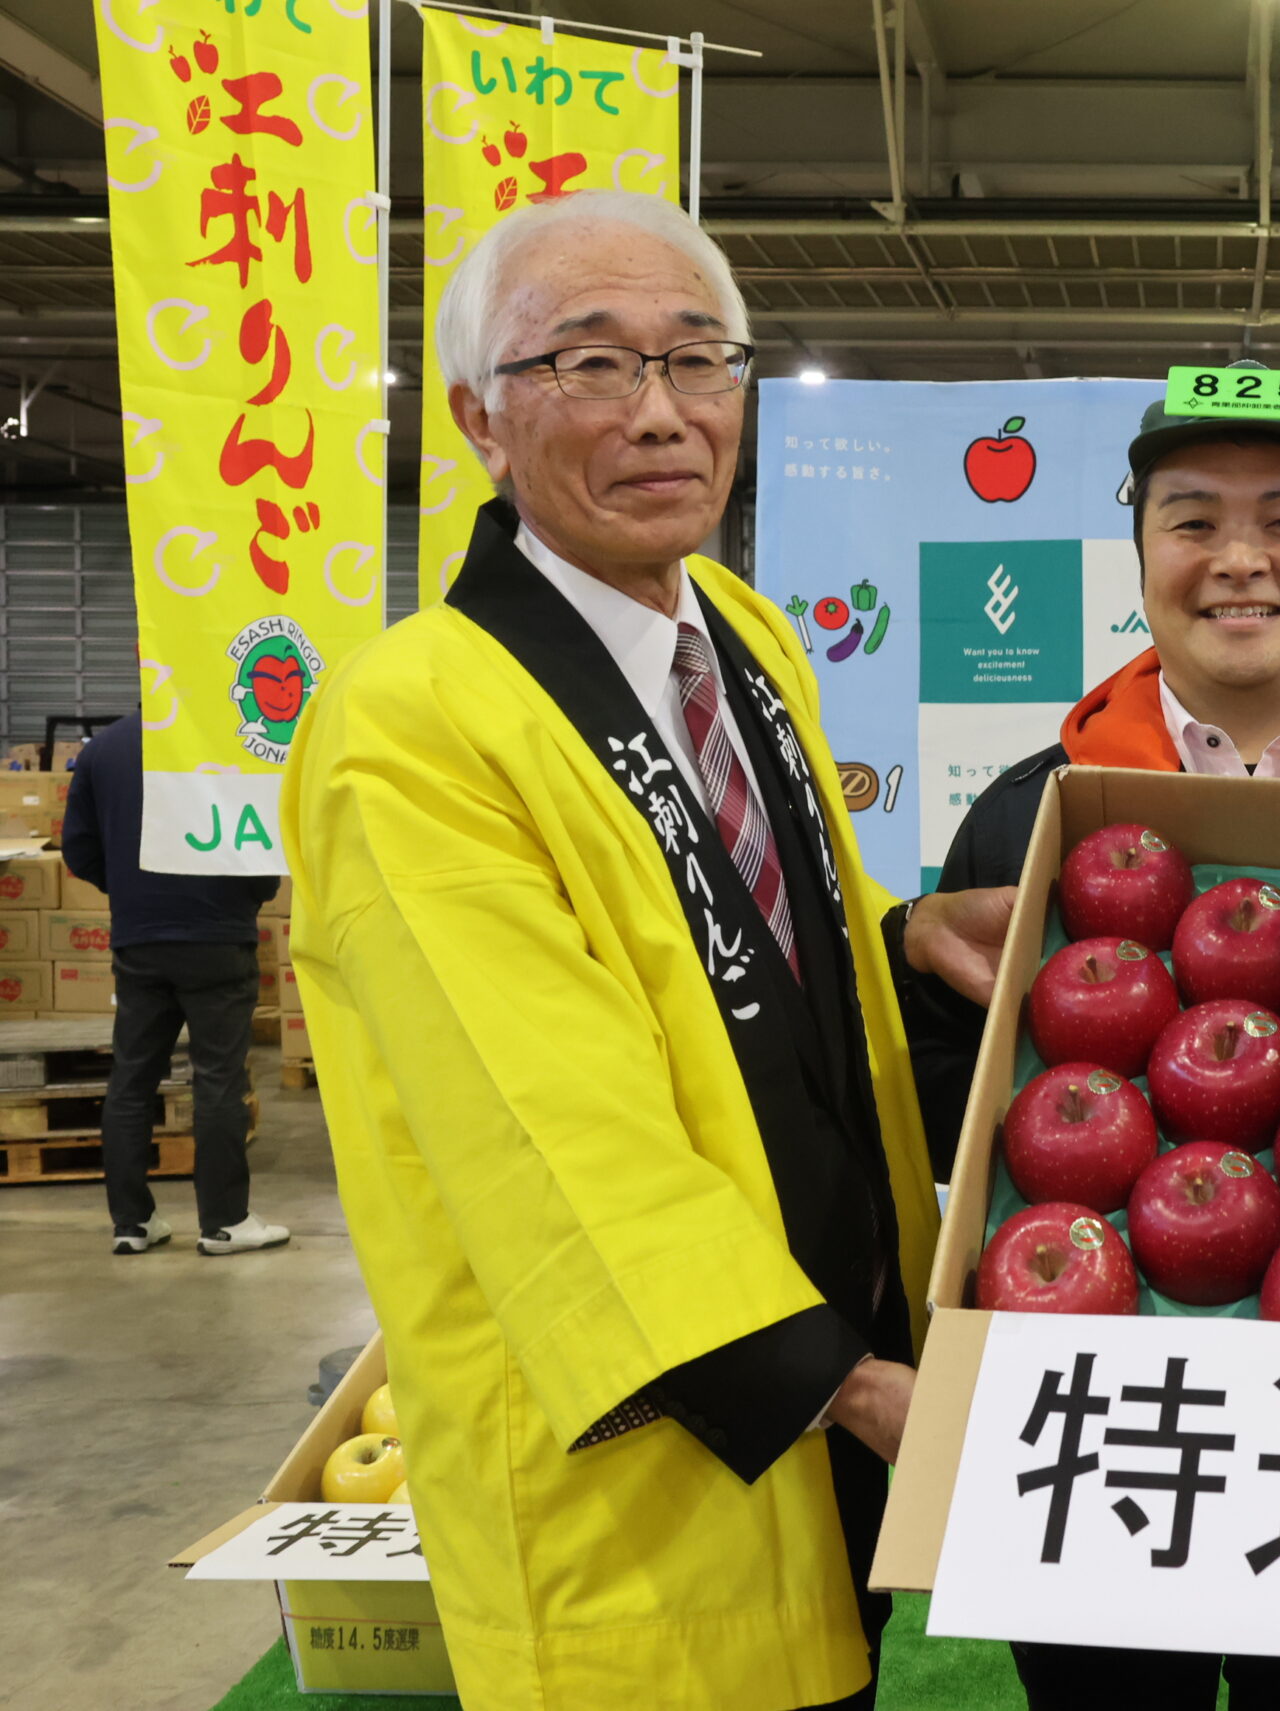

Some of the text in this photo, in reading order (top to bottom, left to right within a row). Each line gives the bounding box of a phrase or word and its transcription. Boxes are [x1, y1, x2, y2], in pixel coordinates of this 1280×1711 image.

[471, 49, 625, 116] いわて
[168, 30, 320, 595] 江刺りんご
[784, 435, 893, 453] 知って欲しい。
[784, 463, 892, 480] 感動する旨さ。
[287, 622, 322, 672] RINGO
[963, 647, 1040, 657] Want you to know
[973, 674, 1033, 683] deliciousness
[977, 661, 1026, 670] excitement
[184, 803, 273, 852] JA
[607, 732, 761, 1020] 江刺りんご
